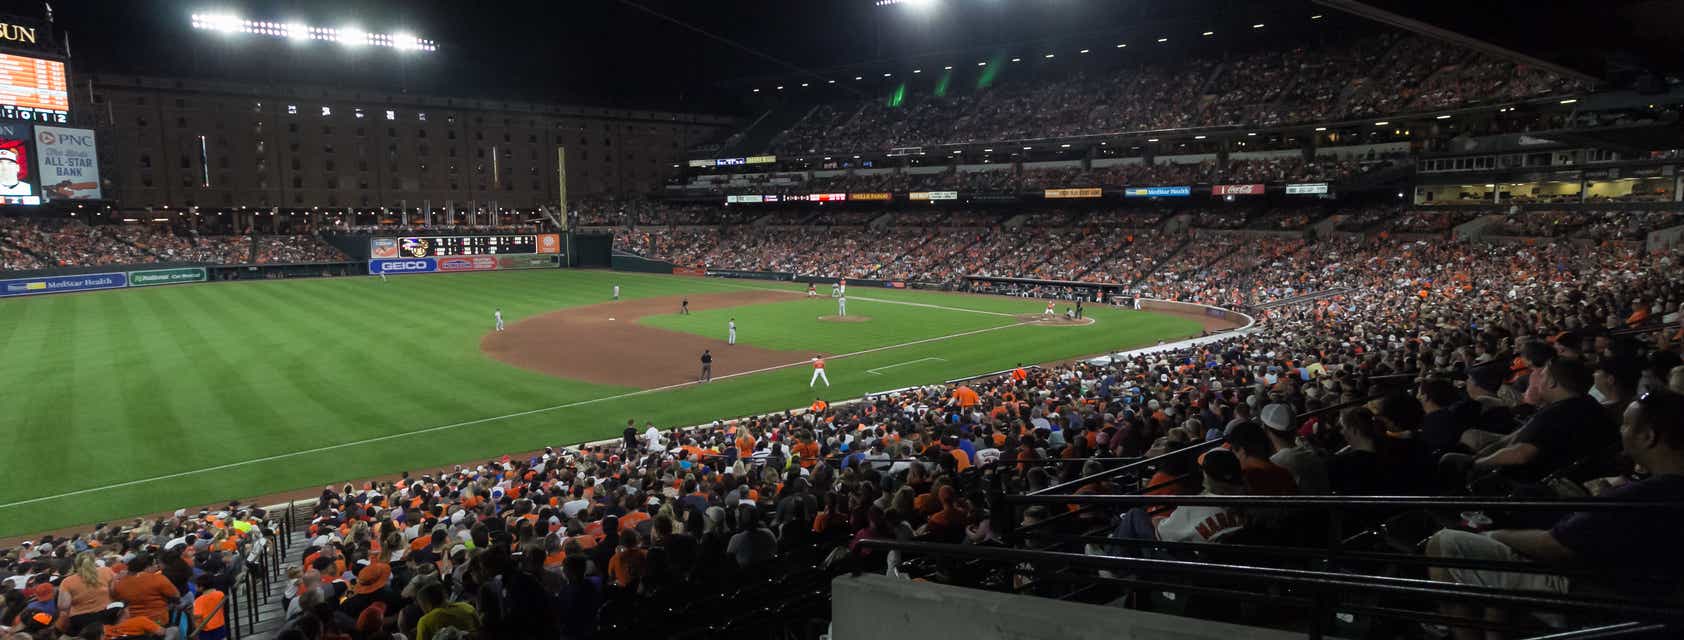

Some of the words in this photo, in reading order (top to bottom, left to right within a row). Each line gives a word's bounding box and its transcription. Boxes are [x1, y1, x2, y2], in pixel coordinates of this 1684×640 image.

[58, 134, 93, 147] PNC
[45, 157, 93, 168] ALL-STAR
[56, 167, 82, 177] BANK
[382, 261, 427, 270] GEICO
[48, 281, 84, 289] MedStar
[85, 278, 112, 286] Health
